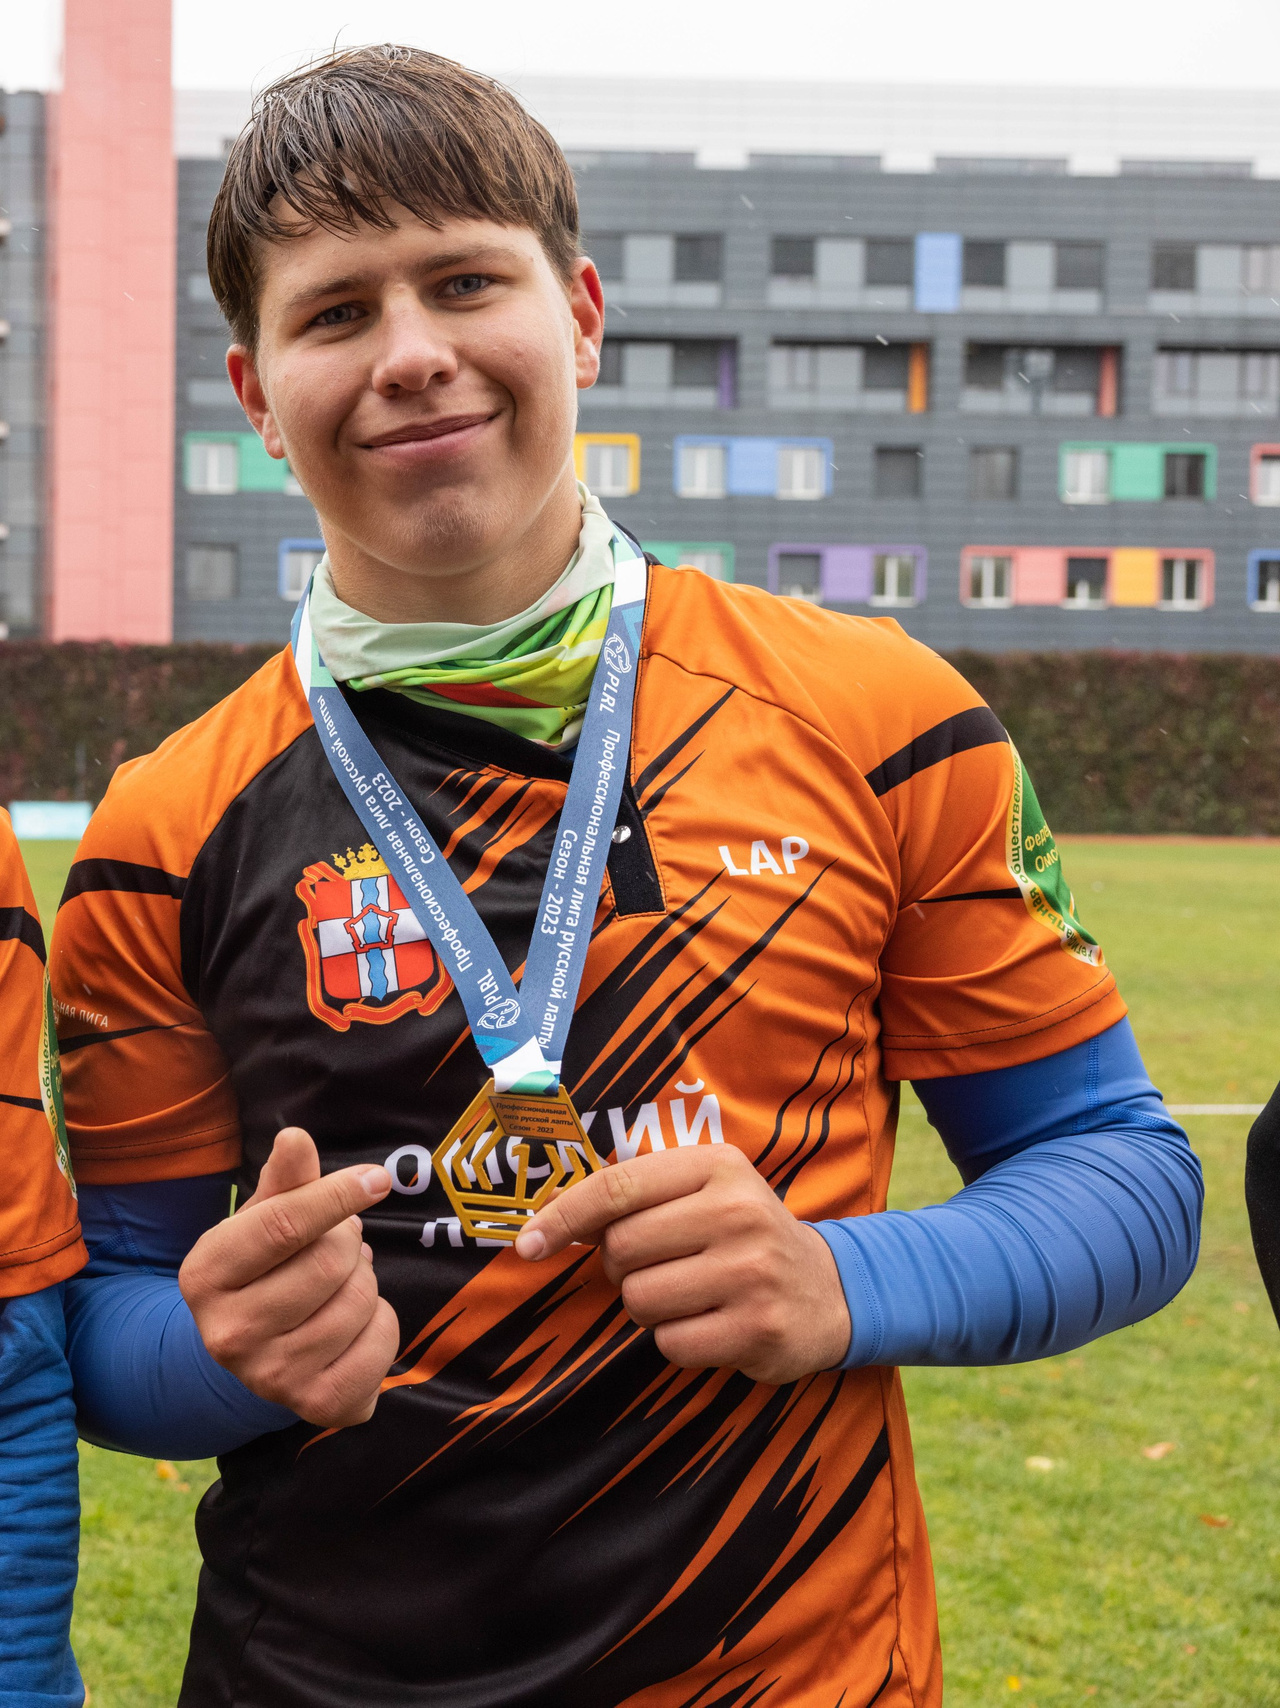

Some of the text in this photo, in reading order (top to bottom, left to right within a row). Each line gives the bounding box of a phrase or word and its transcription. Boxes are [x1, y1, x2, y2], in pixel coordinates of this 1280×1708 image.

[599, 671, 620, 714] PLRL
[372, 772, 403, 811] 2023
[317, 694, 474, 973] Профессиональная лига русской лапты
[403, 817, 436, 865] Сезон
[553, 829, 578, 881] Сезон
[717, 835, 810, 878] LAP
[537, 728, 621, 1049] Профессиональная лига русской лапты
[540, 892, 564, 936] 2023
[476, 967, 503, 1007] PLRL
[496, 1102, 567, 1116] Профессиональная
[520, 1116, 550, 1124] русской
[536, 1126, 555, 1134] 2023
